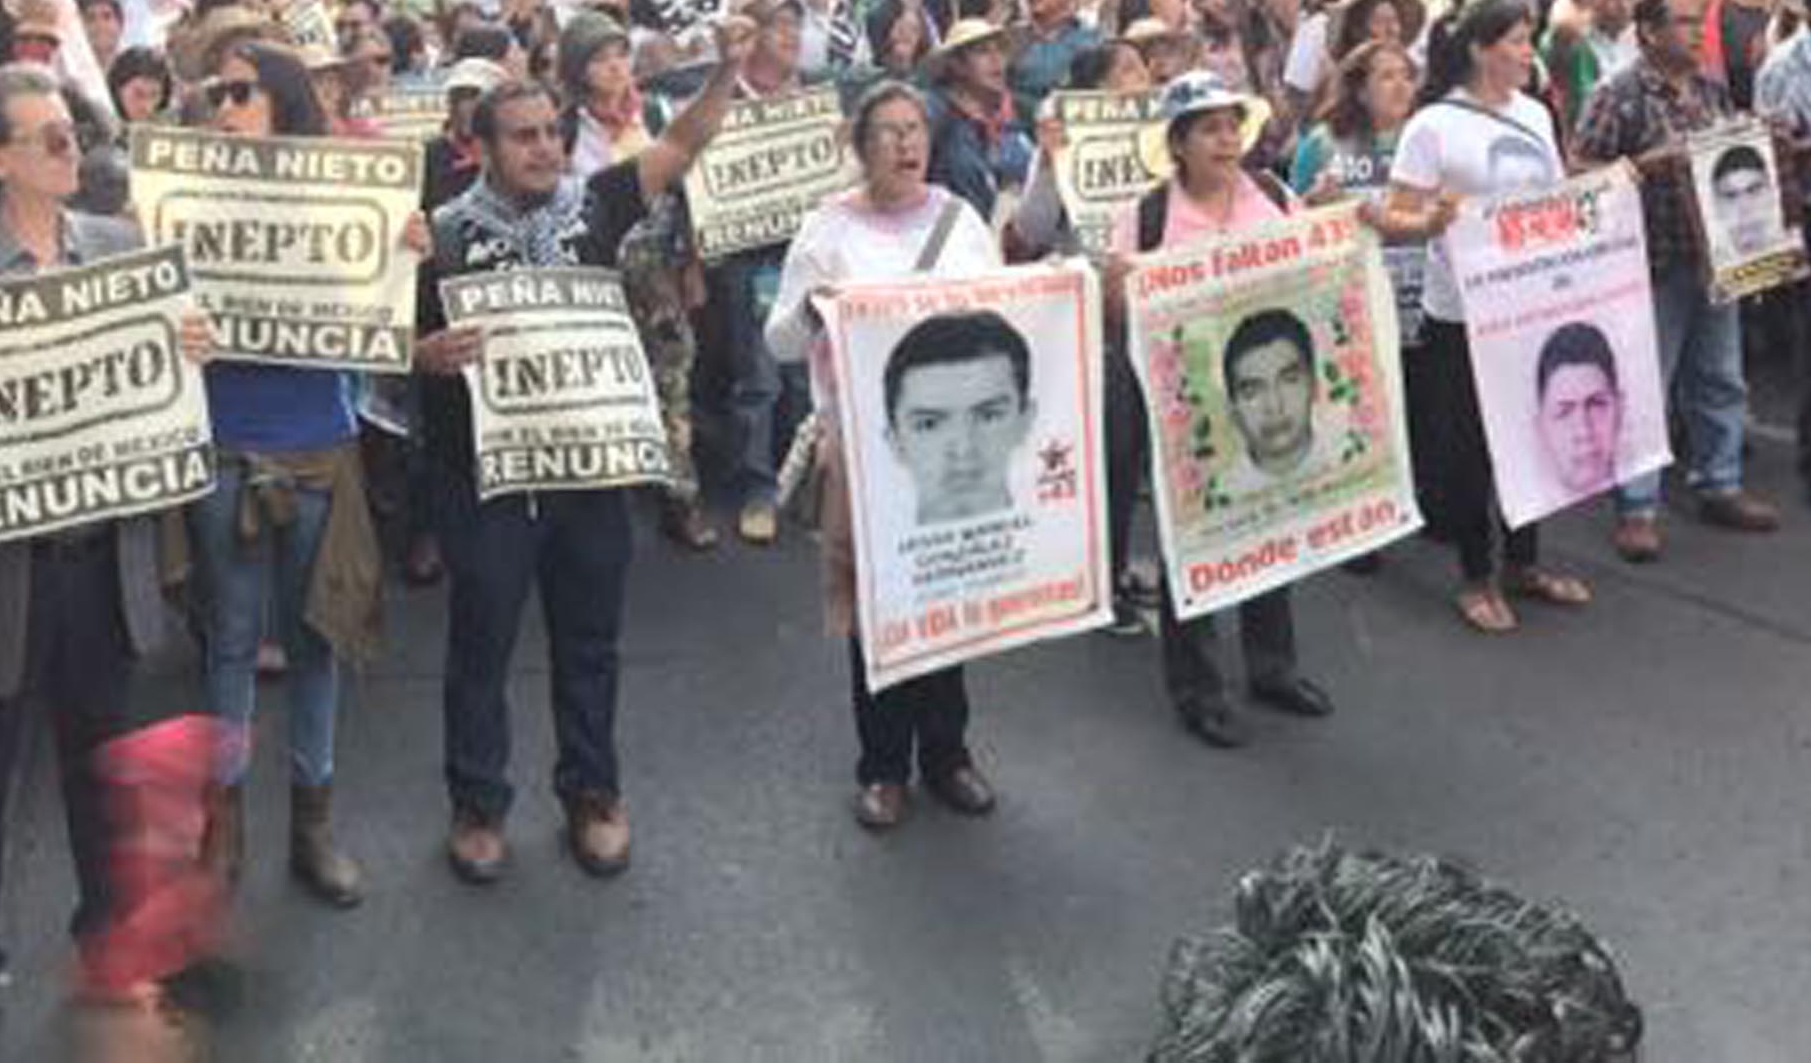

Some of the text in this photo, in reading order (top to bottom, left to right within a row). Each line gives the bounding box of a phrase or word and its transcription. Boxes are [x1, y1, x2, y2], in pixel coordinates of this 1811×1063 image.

[146, 139, 407, 183] PEÑA NIETO
[61, 260, 179, 315] NIETO
[458, 274, 563, 313] PEÑA
[209, 315, 400, 363] NUNCIA
